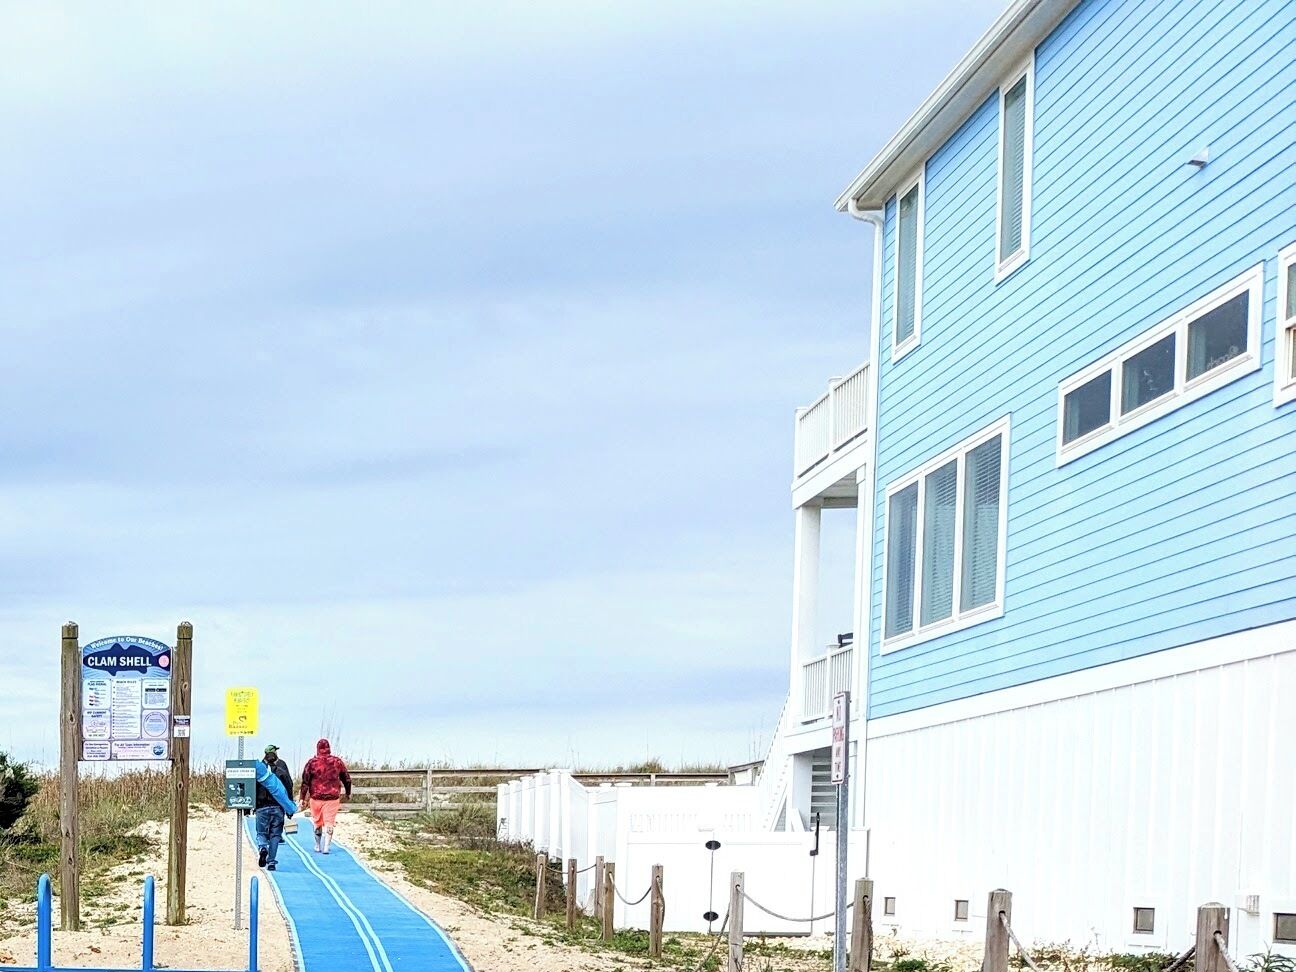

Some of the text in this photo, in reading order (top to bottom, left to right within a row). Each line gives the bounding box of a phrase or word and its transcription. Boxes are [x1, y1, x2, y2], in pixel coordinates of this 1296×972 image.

[90, 638, 117, 649] Welcome
[87, 656, 117, 667] CLAM
[119, 656, 152, 667] SHELL
